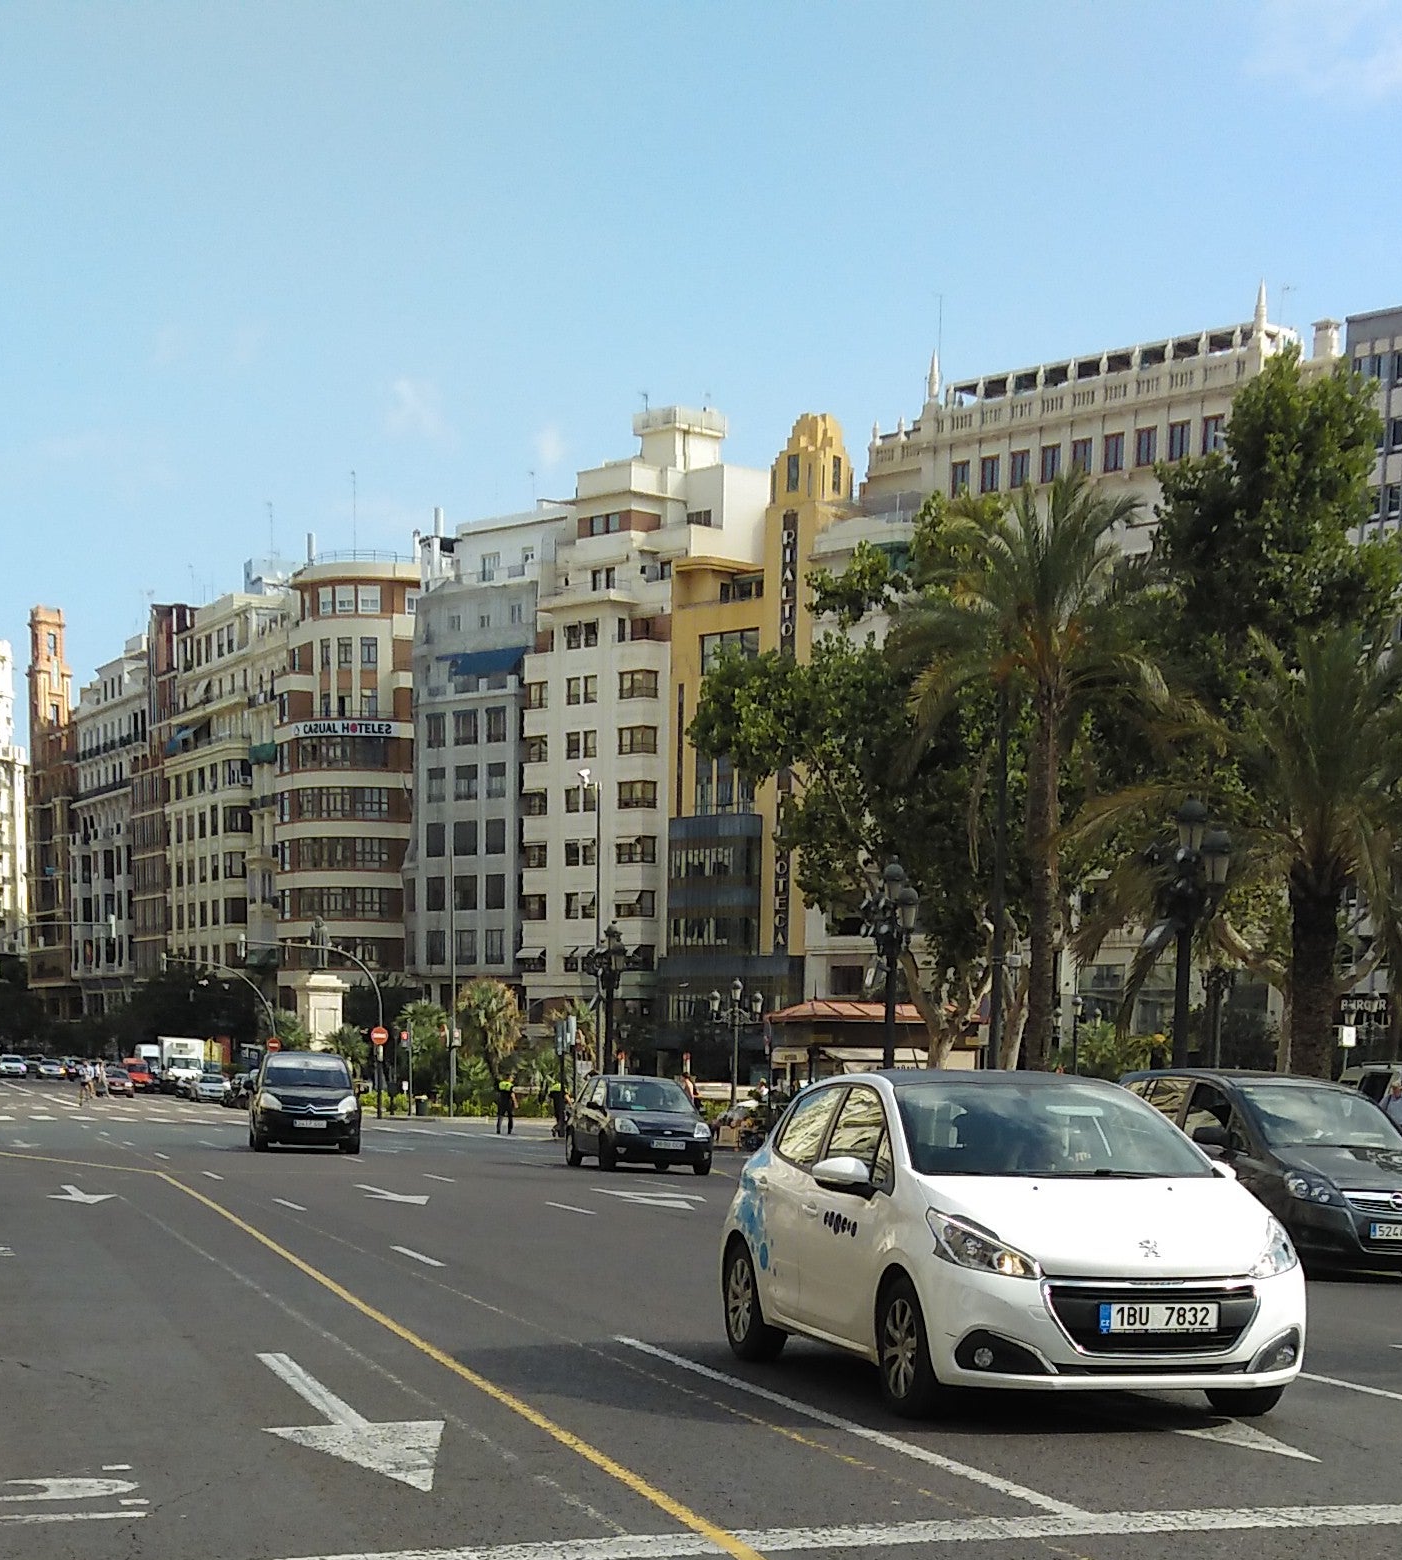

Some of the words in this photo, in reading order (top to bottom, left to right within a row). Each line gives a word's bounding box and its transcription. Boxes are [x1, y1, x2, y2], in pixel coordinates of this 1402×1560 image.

[781, 529, 796, 637] RIALTO
[303, 722, 338, 735] CASUAL
[342, 722, 392, 735] HOTELES
[1340, 999, 1387, 1011] BRGR
[1116, 1306, 1150, 1327] 1BU
[1164, 1306, 1210, 1327] 7832
